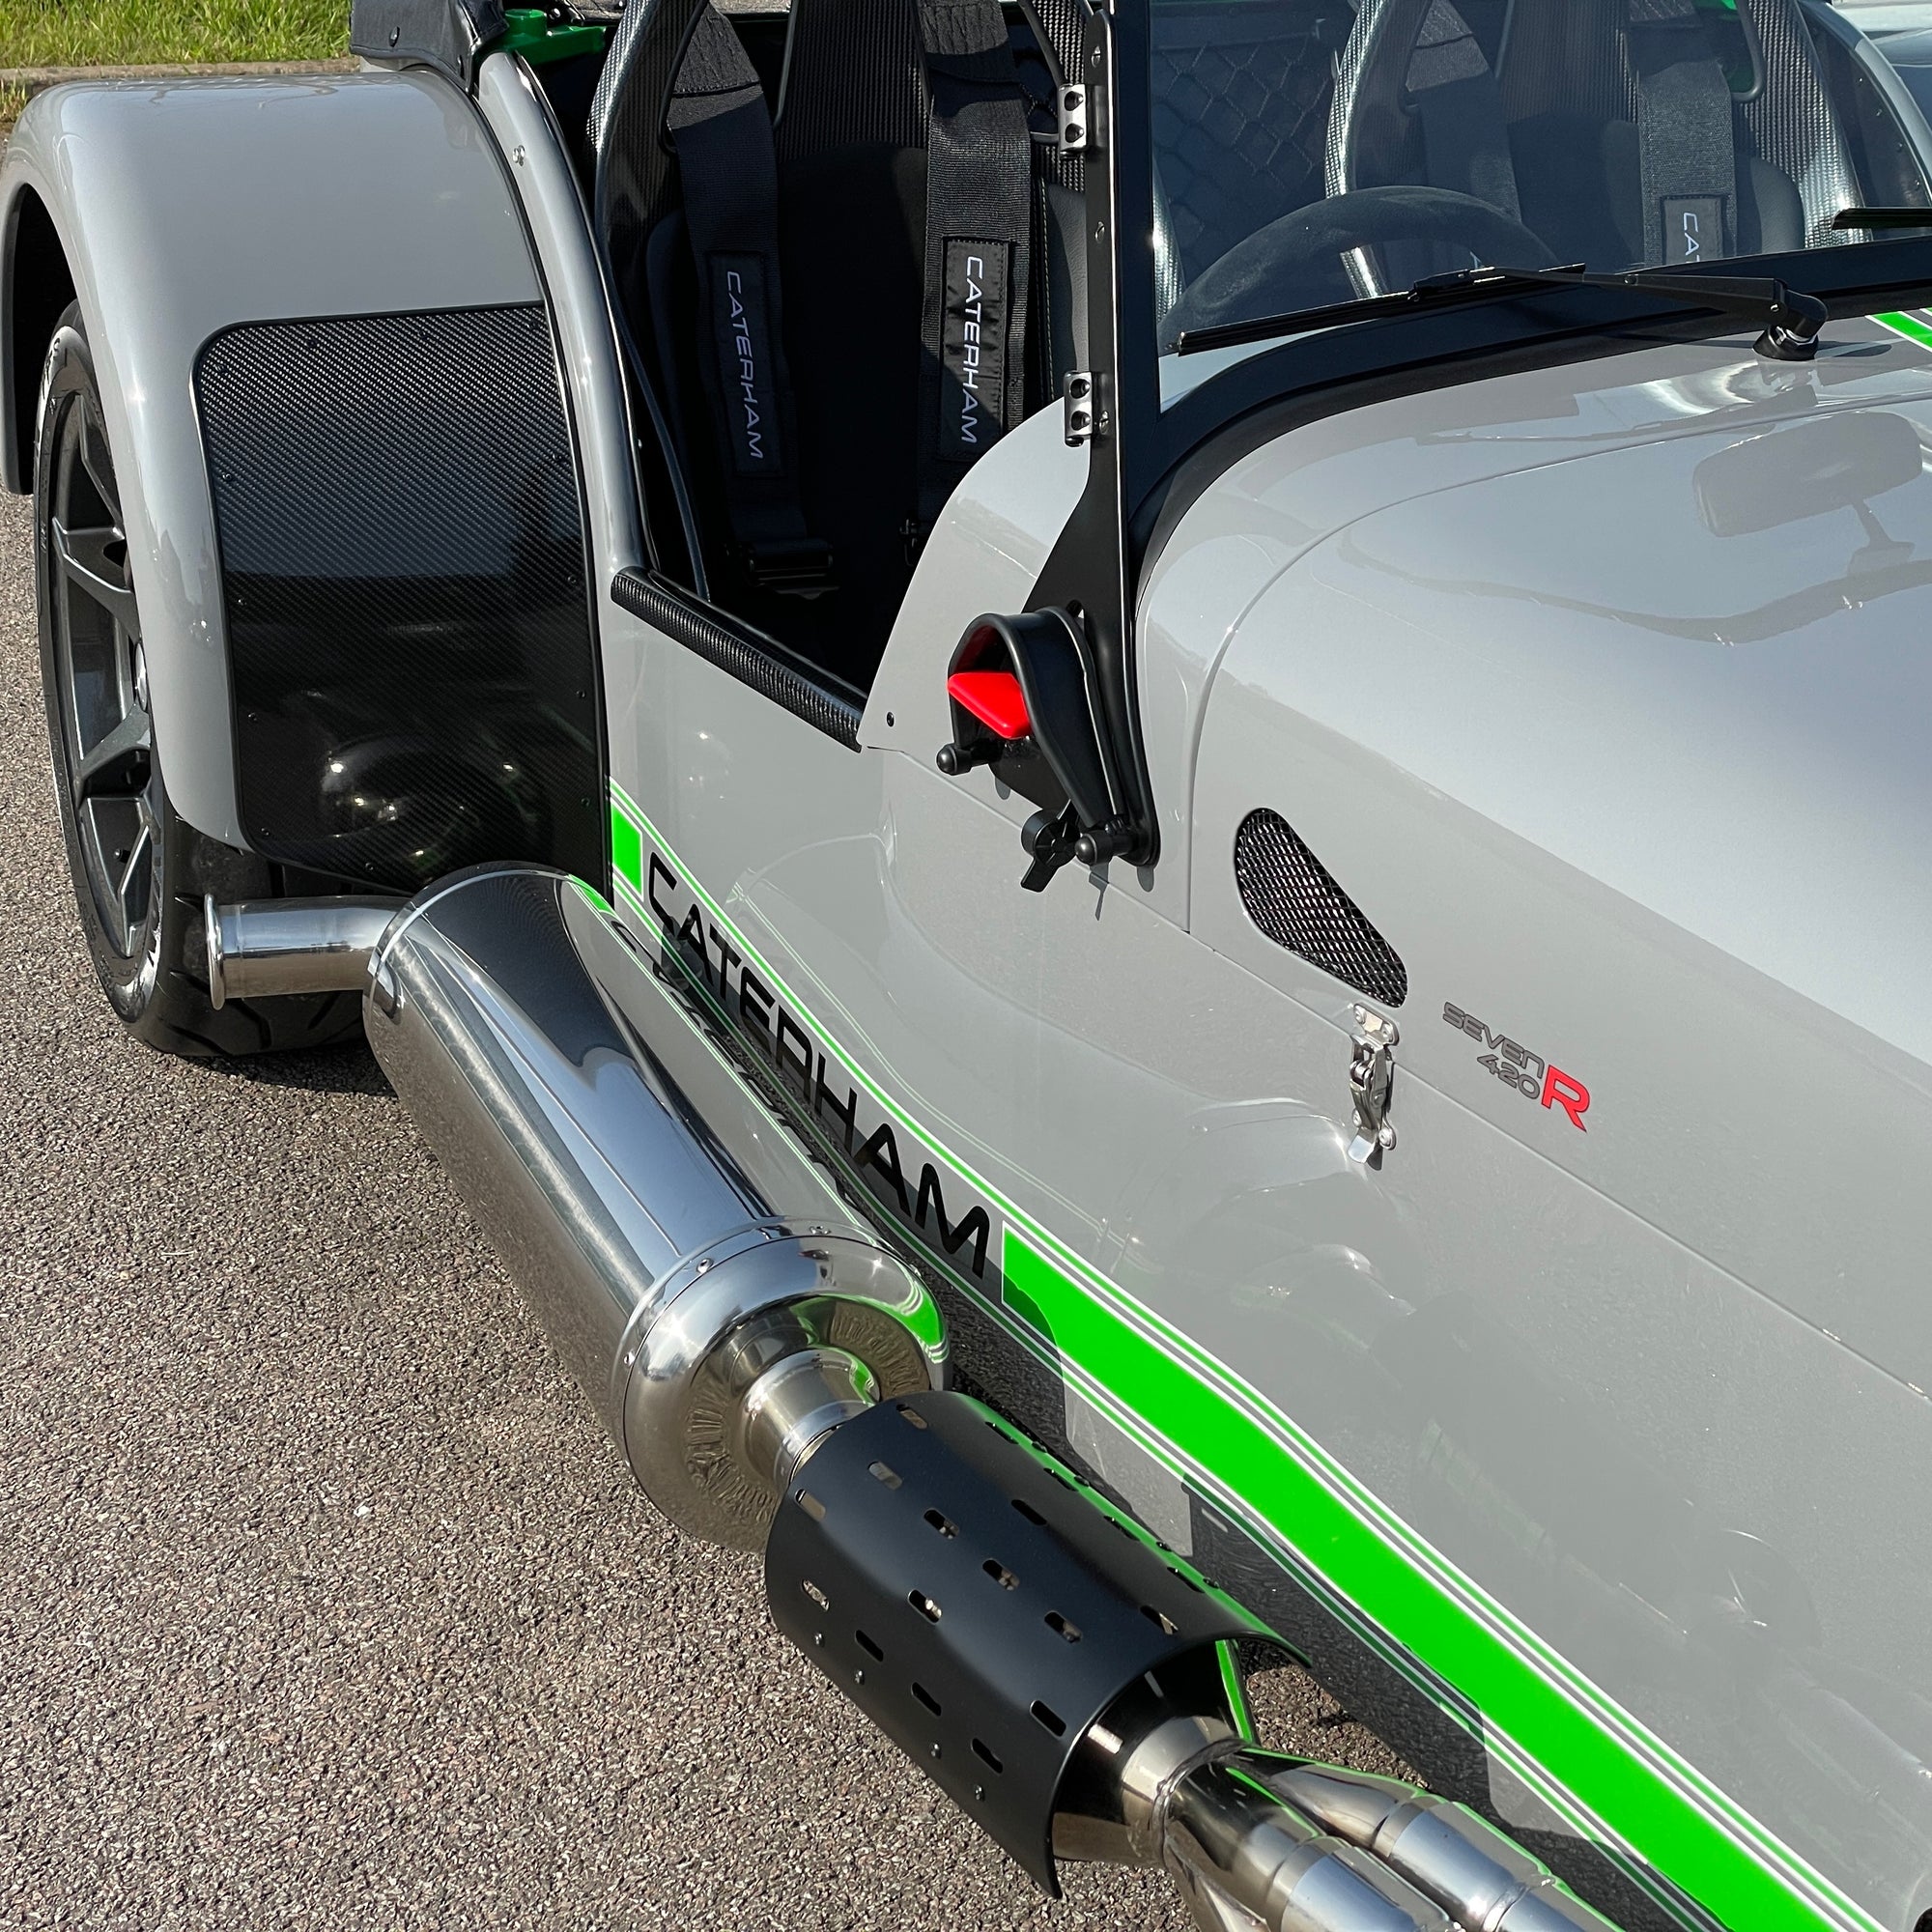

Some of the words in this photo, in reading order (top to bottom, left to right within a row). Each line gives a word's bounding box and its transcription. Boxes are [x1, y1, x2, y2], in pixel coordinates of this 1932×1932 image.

[726, 270, 764, 459] CATERHAM
[960, 256, 983, 444] CATERHAM
[648, 852, 990, 1279] CATERHAM
[1476, 1053, 1541, 1100] 420
[1541, 1064, 1591, 1133] R
